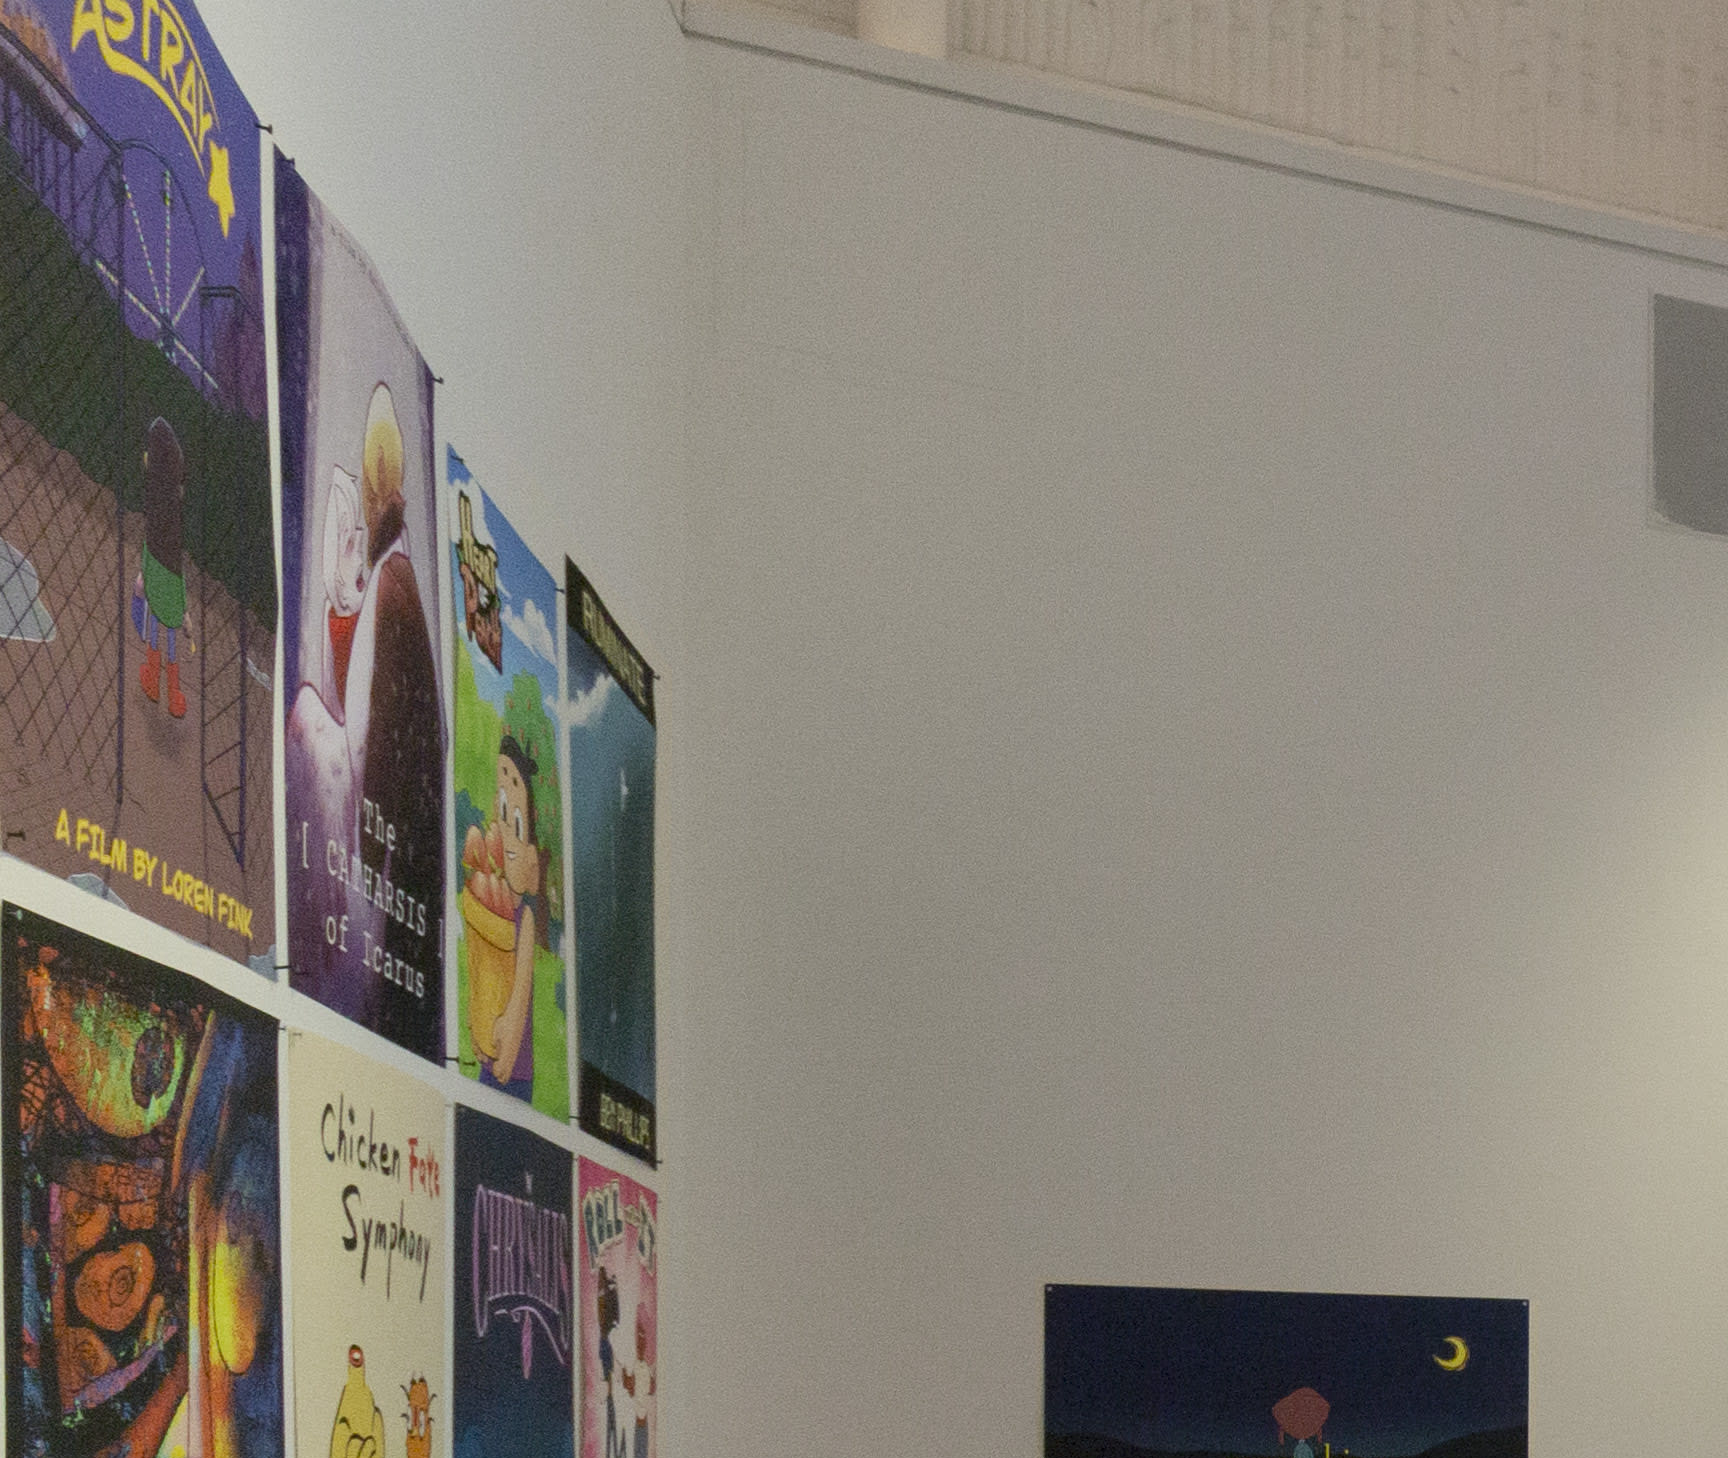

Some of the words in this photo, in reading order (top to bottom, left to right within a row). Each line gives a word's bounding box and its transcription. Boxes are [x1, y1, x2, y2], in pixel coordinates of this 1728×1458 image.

[71, 0, 213, 153] ASTRAY
[363, 798, 396, 851] The
[55, 808, 70, 846] A
[76, 818, 127, 873] FILM
[132, 848, 158, 887] BY
[162, 861, 214, 918] LOREN
[218, 893, 253, 940] FINK
[327, 839, 426, 937] CATHARSIS
[326, 915, 349, 953] of
[363, 930, 425, 998] Icarus
[321, 1092, 400, 1184] Chicken
[342, 1184, 430, 1304] Symphony
